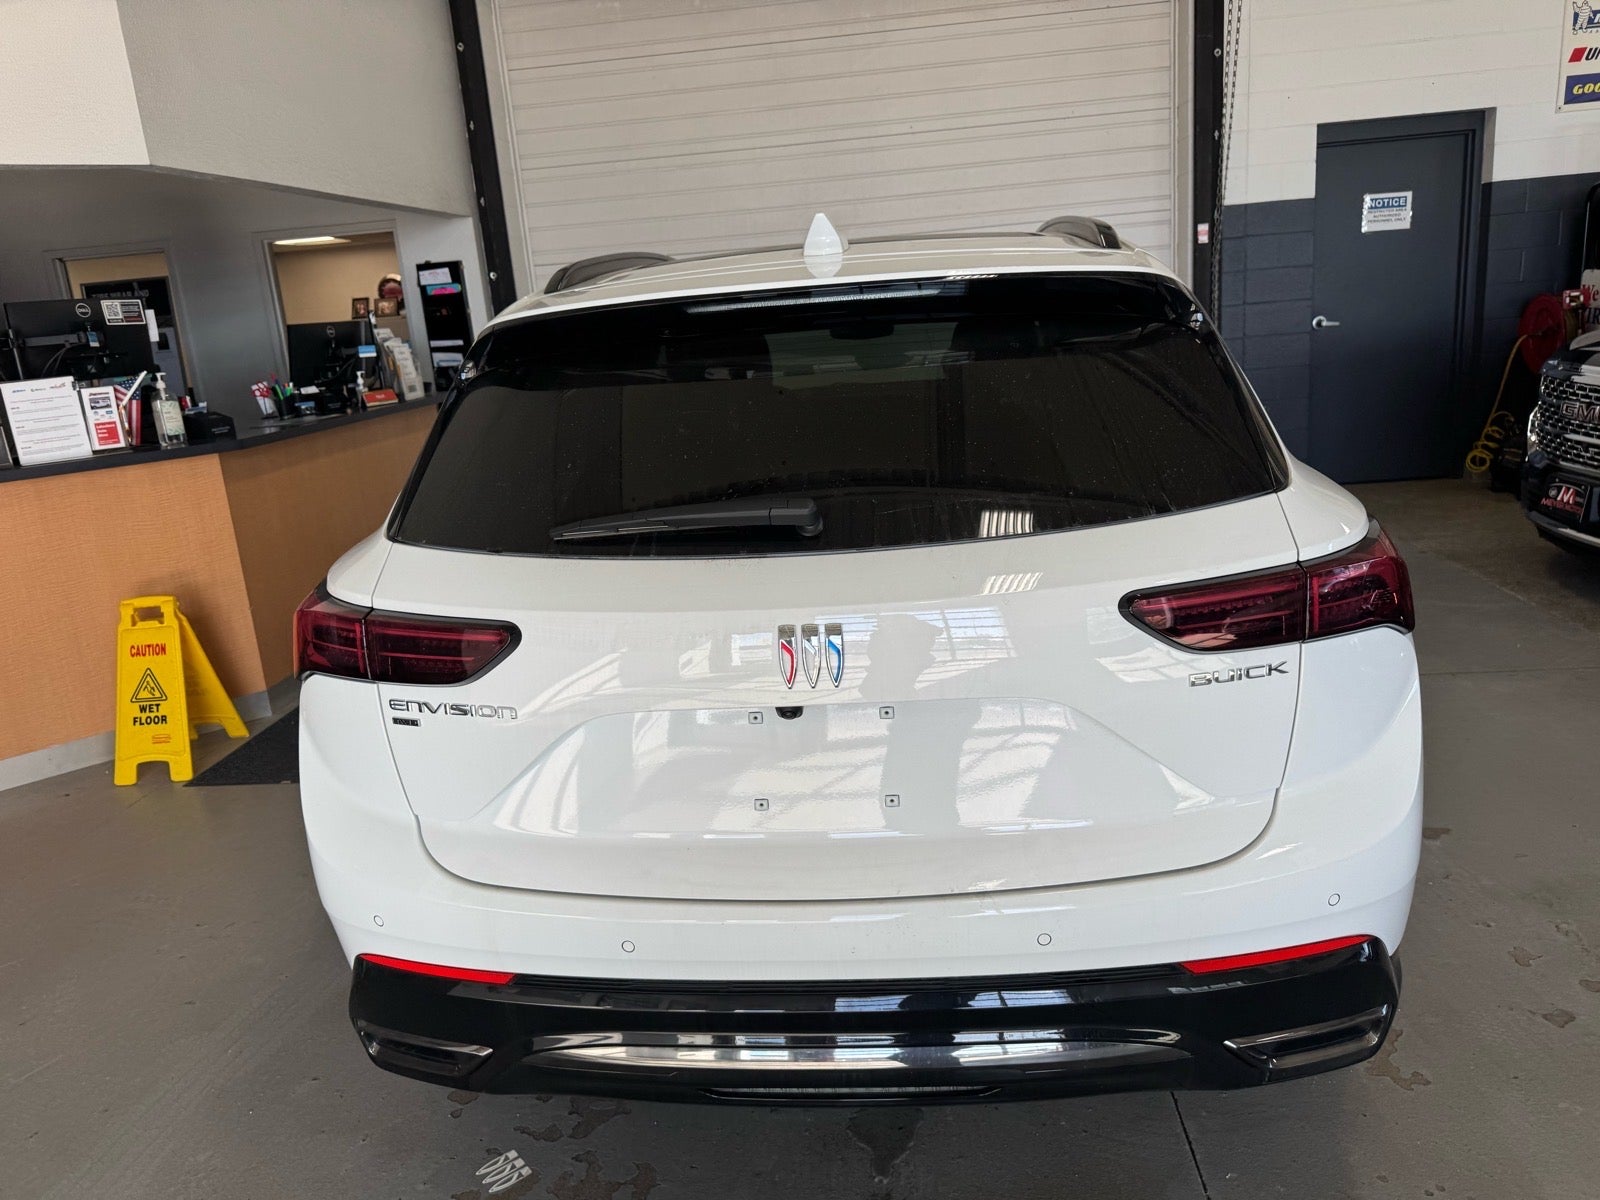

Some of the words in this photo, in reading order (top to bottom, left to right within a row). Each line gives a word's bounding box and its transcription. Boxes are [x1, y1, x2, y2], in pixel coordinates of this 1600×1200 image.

[1369, 197, 1406, 208] NOTICE
[1562, 401, 1600, 424] GM
[130, 643, 167, 658] CAUTION
[1189, 661, 1289, 687] BUICK
[139, 704, 161, 713] WET
[389, 699, 518, 720] ENVISION
[133, 715, 167, 726] FLOOR
